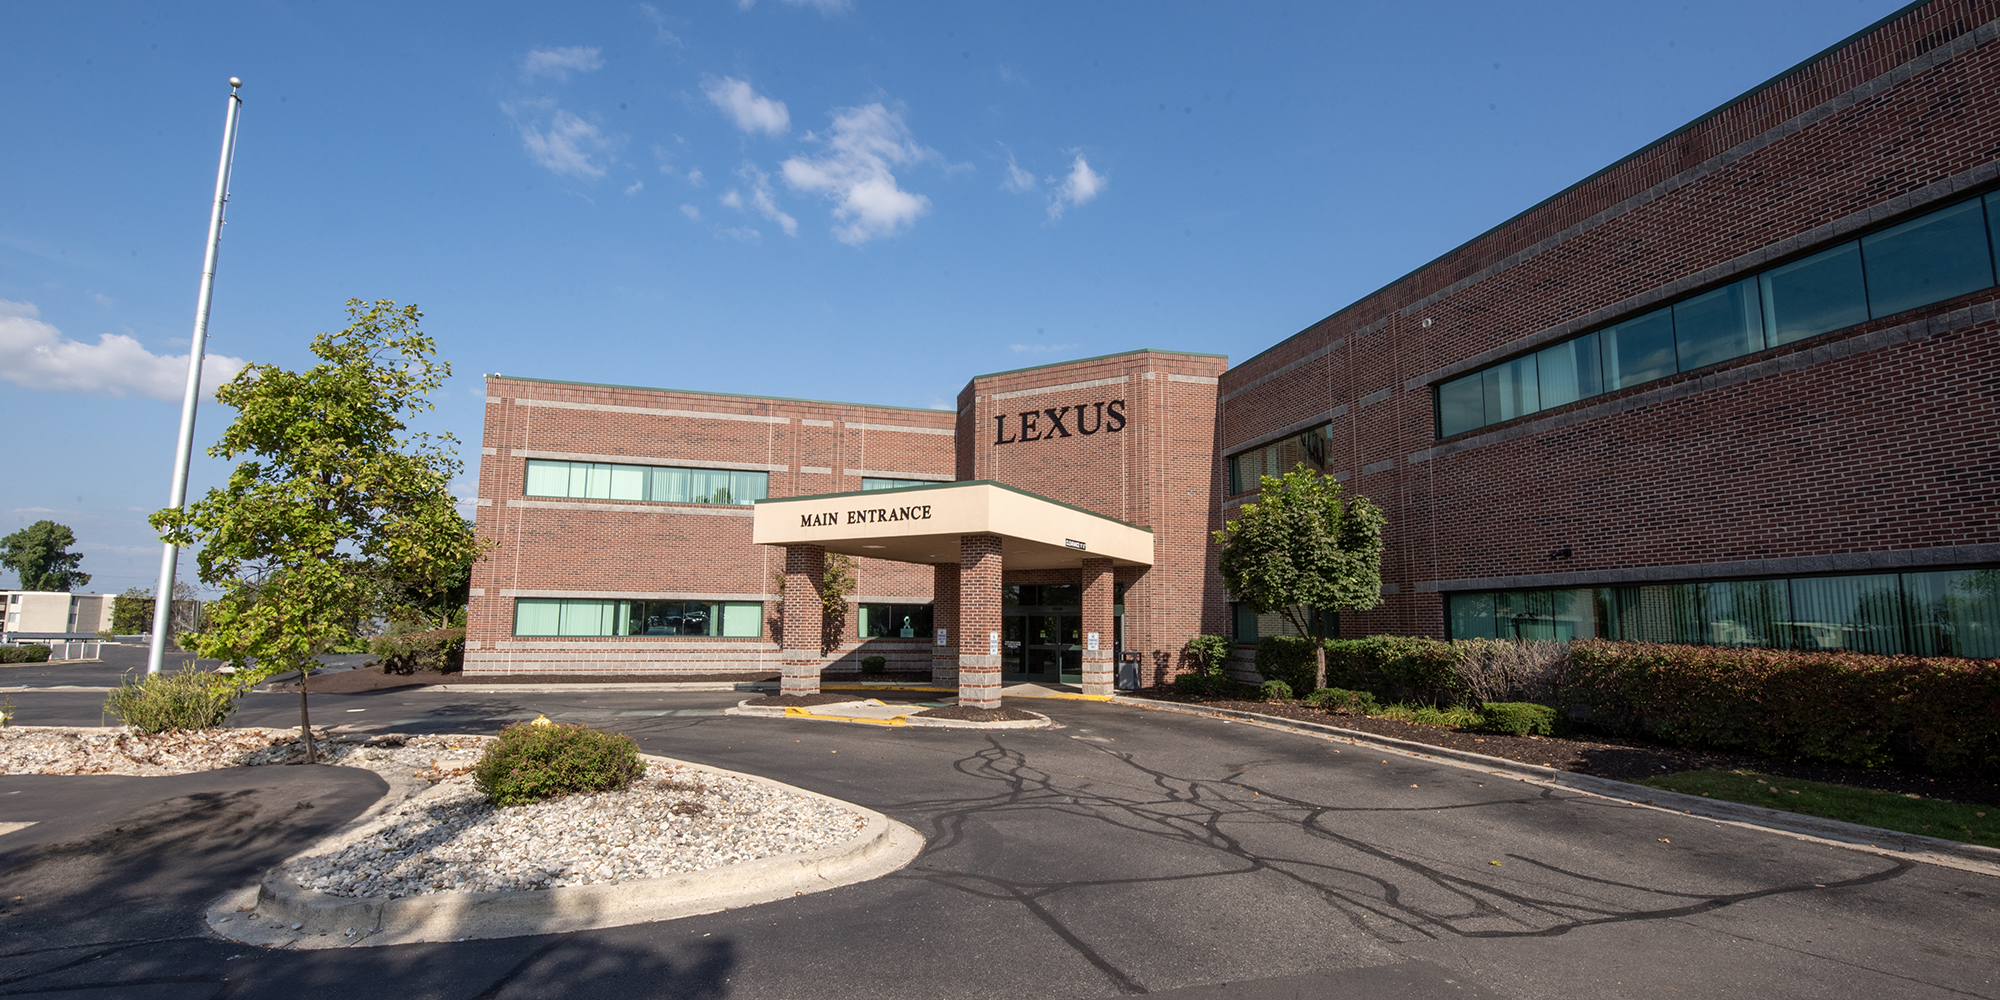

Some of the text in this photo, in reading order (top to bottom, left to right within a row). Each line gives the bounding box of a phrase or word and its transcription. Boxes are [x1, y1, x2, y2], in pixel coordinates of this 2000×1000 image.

[993, 399, 1127, 446] LEXUS
[800, 505, 932, 527] MAIN ENTRANCE
